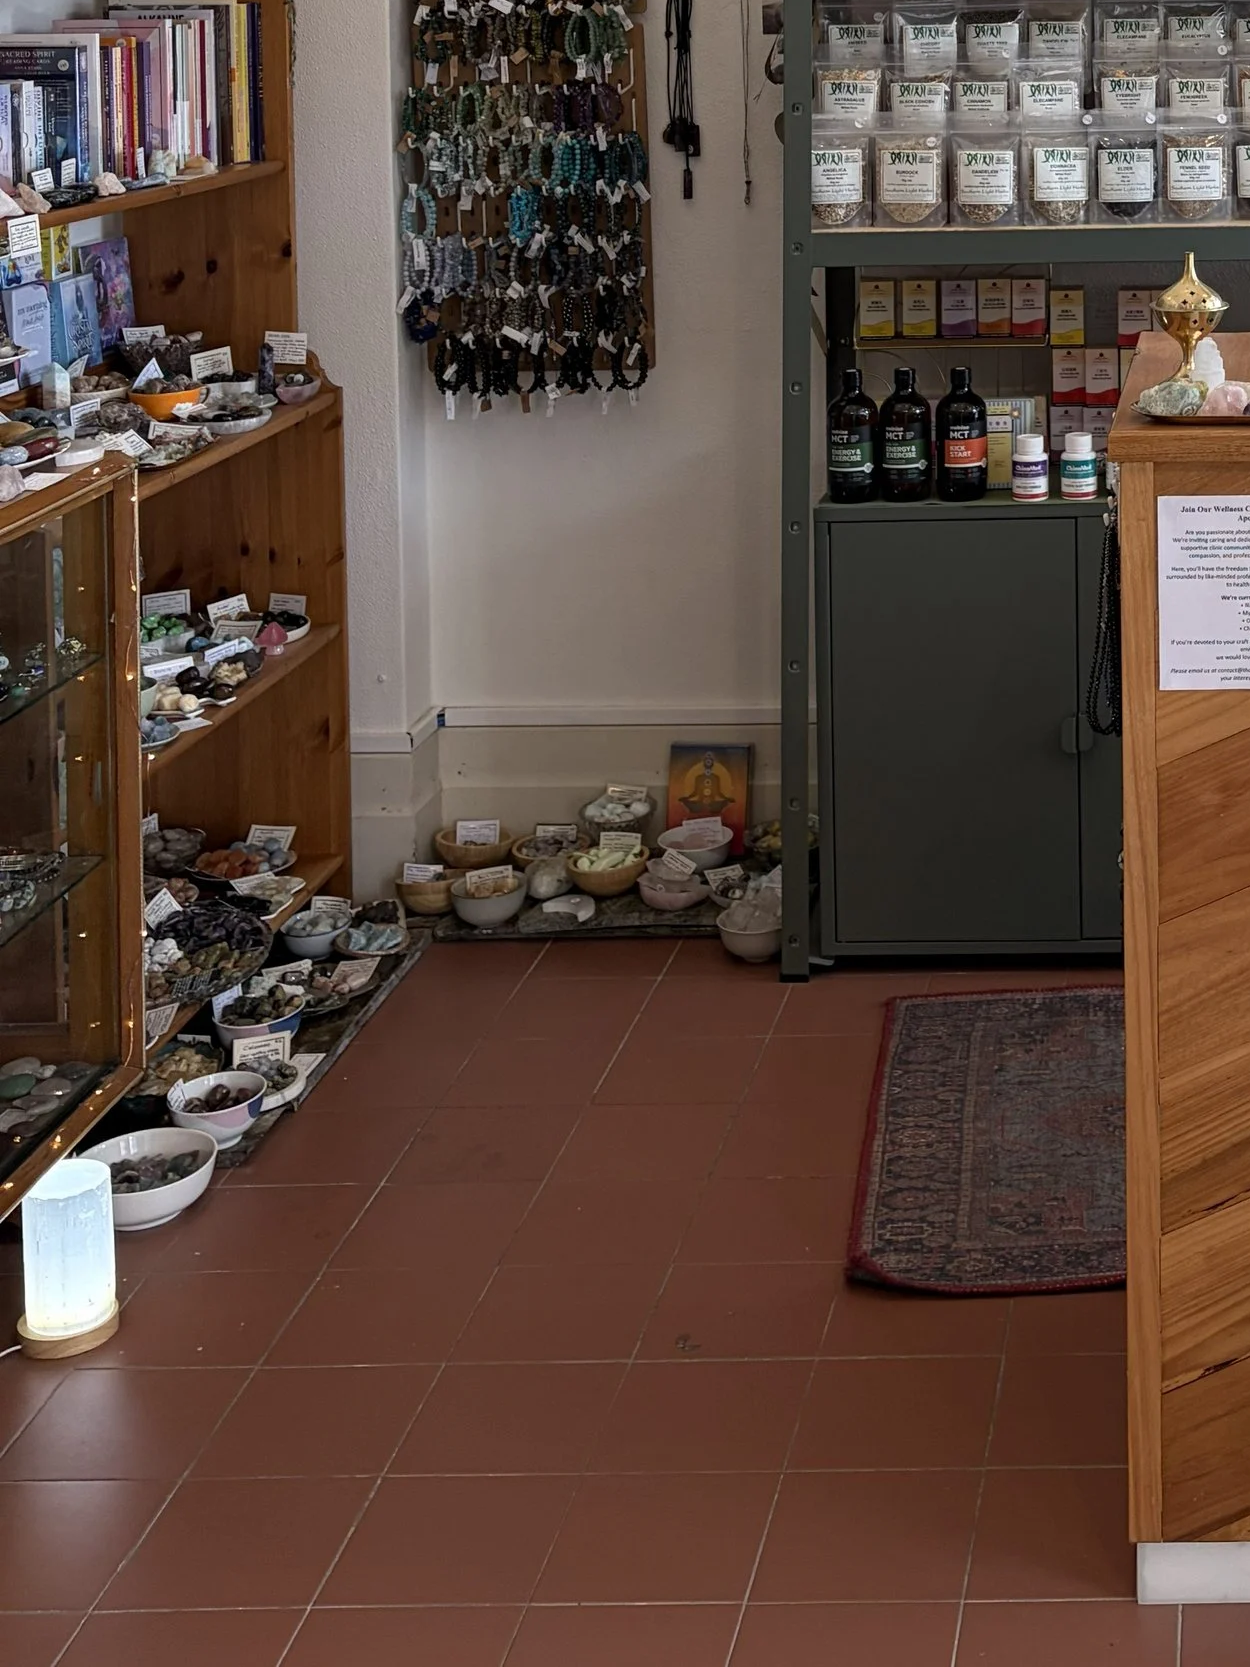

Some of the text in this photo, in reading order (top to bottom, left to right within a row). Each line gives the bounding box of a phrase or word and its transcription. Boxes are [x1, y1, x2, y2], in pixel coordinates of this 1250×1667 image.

[832, 435, 848, 443] MCT
[886, 432, 903, 440] MCT
[949, 431, 970, 439] MCT
